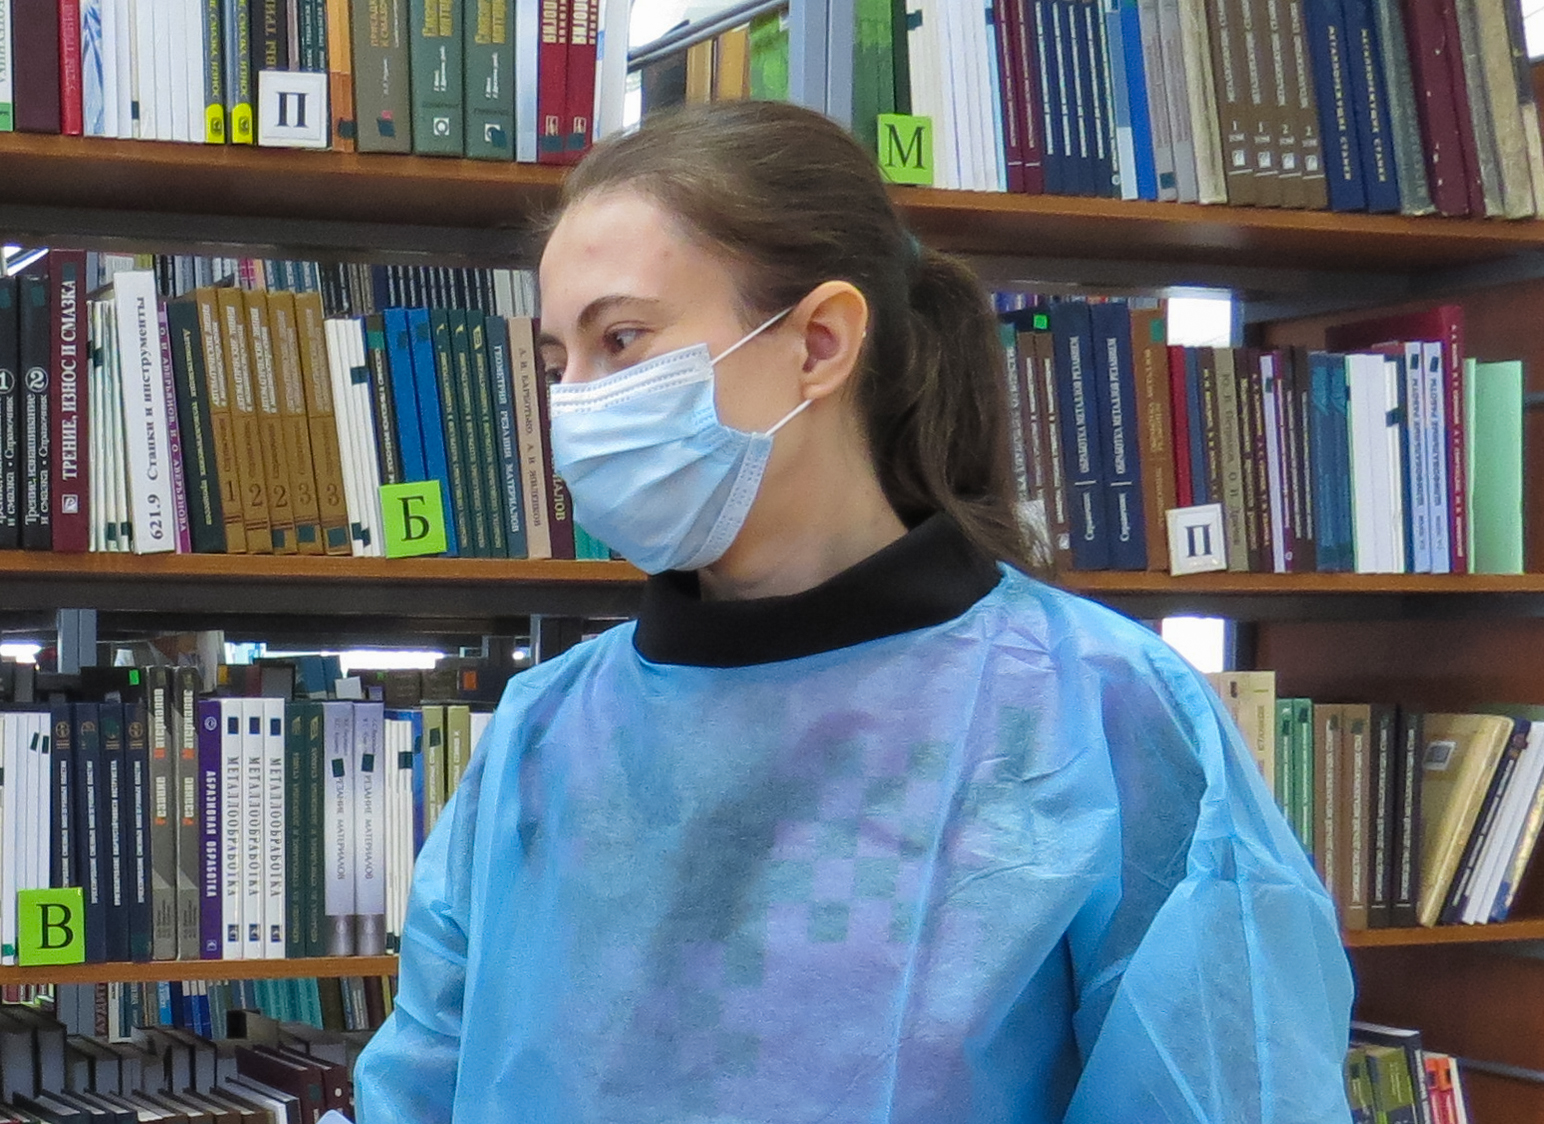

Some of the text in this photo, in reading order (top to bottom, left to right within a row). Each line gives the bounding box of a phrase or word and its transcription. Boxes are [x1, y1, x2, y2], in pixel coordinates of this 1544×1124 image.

[275, 92, 310, 127] П
[887, 124, 925, 170] М
[29, 370, 45, 389] 2
[61, 281, 78, 480] ТРЕНИЕ, ИЗНОС И СМАЗКА
[5, 396, 15, 459] Справочник
[39, 394, 49, 457] Справочник
[136, 297, 164, 540] 621.9 Станки и инструменты
[25, 394, 39, 525] Трение, изнашивание
[6, 472, 15, 514] смазка
[39, 470, 49, 513] смазка
[173, 459, 187, 532] АВЕРЬЯНОВА
[399, 496, 432, 543] Б
[506, 464, 519, 532] МАТЕРИАЛОВ
[1184, 524, 1212, 558] П
[227, 756, 239, 896] МЕТАЛЛООБРАБОТКА
[248, 756, 260, 896] МЕТАЛЛООБРАБОТКА
[269, 758, 282, 897] МЕТАЛЛООБРАБОТКА
[337, 819, 345, 879] МАТЕРИАЛОВ
[365, 819, 373, 879] МАТЕРИАЛОВ
[206, 841, 217, 897] ОБРАБОТКА
[36, 902, 76, 949] В
